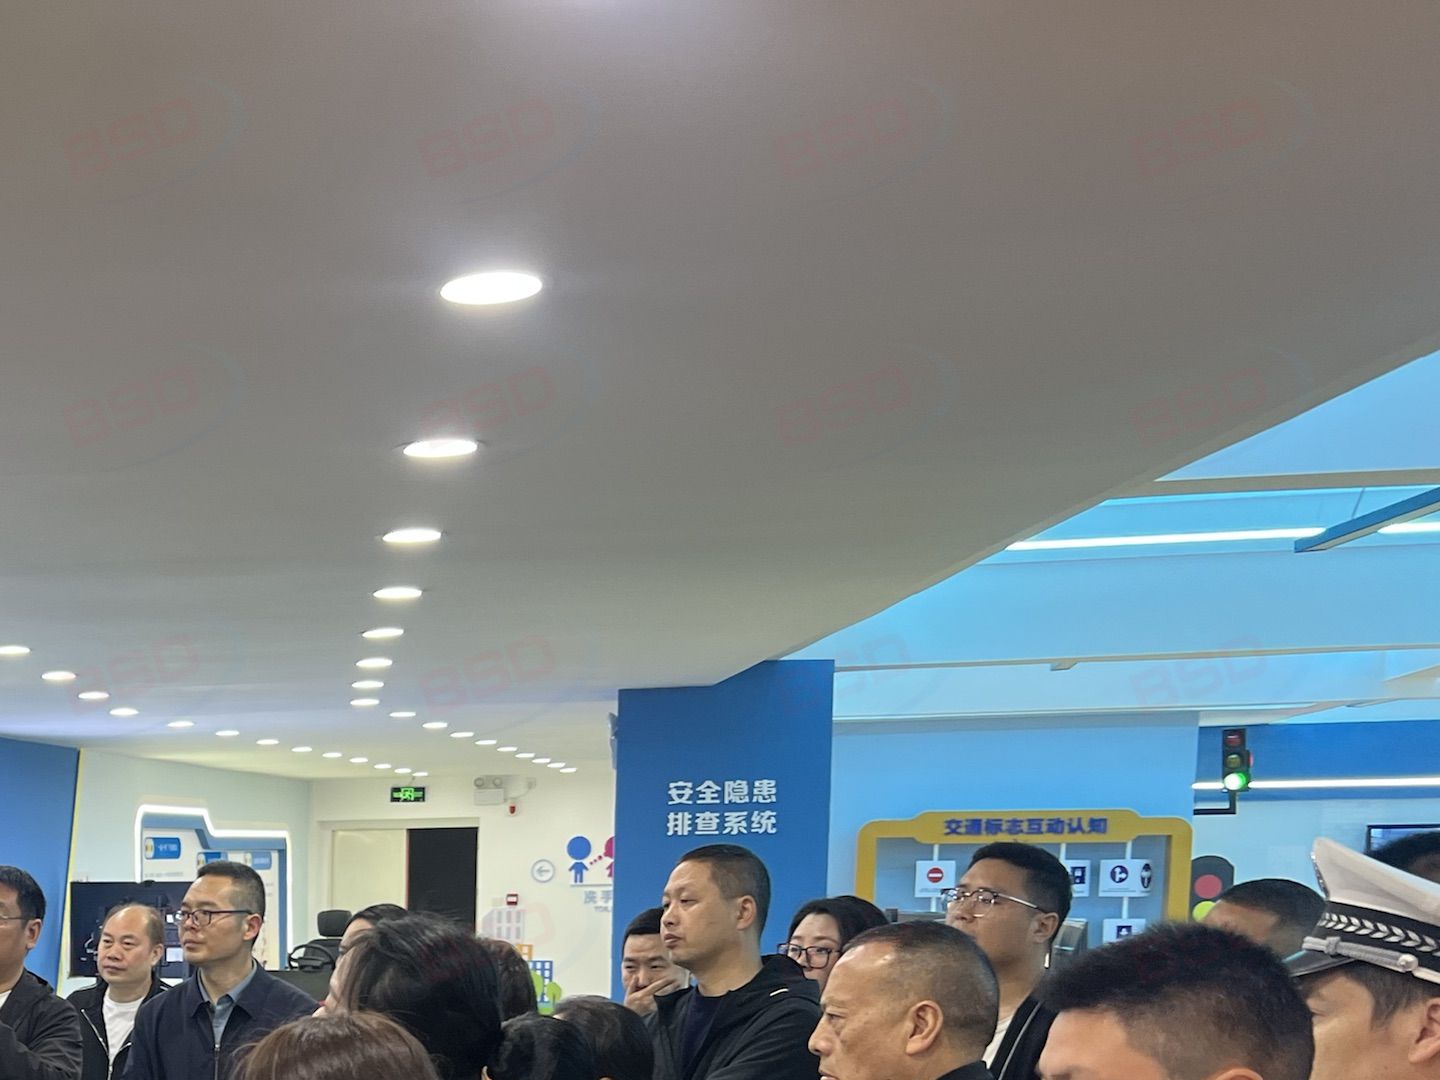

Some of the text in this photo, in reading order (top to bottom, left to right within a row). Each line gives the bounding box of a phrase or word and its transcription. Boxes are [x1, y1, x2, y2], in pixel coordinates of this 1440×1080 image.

[667, 779, 778, 806] 安全隐患
[667, 811, 778, 836] 排查系统
[944, 817, 1108, 836] 交通标志互动认知
